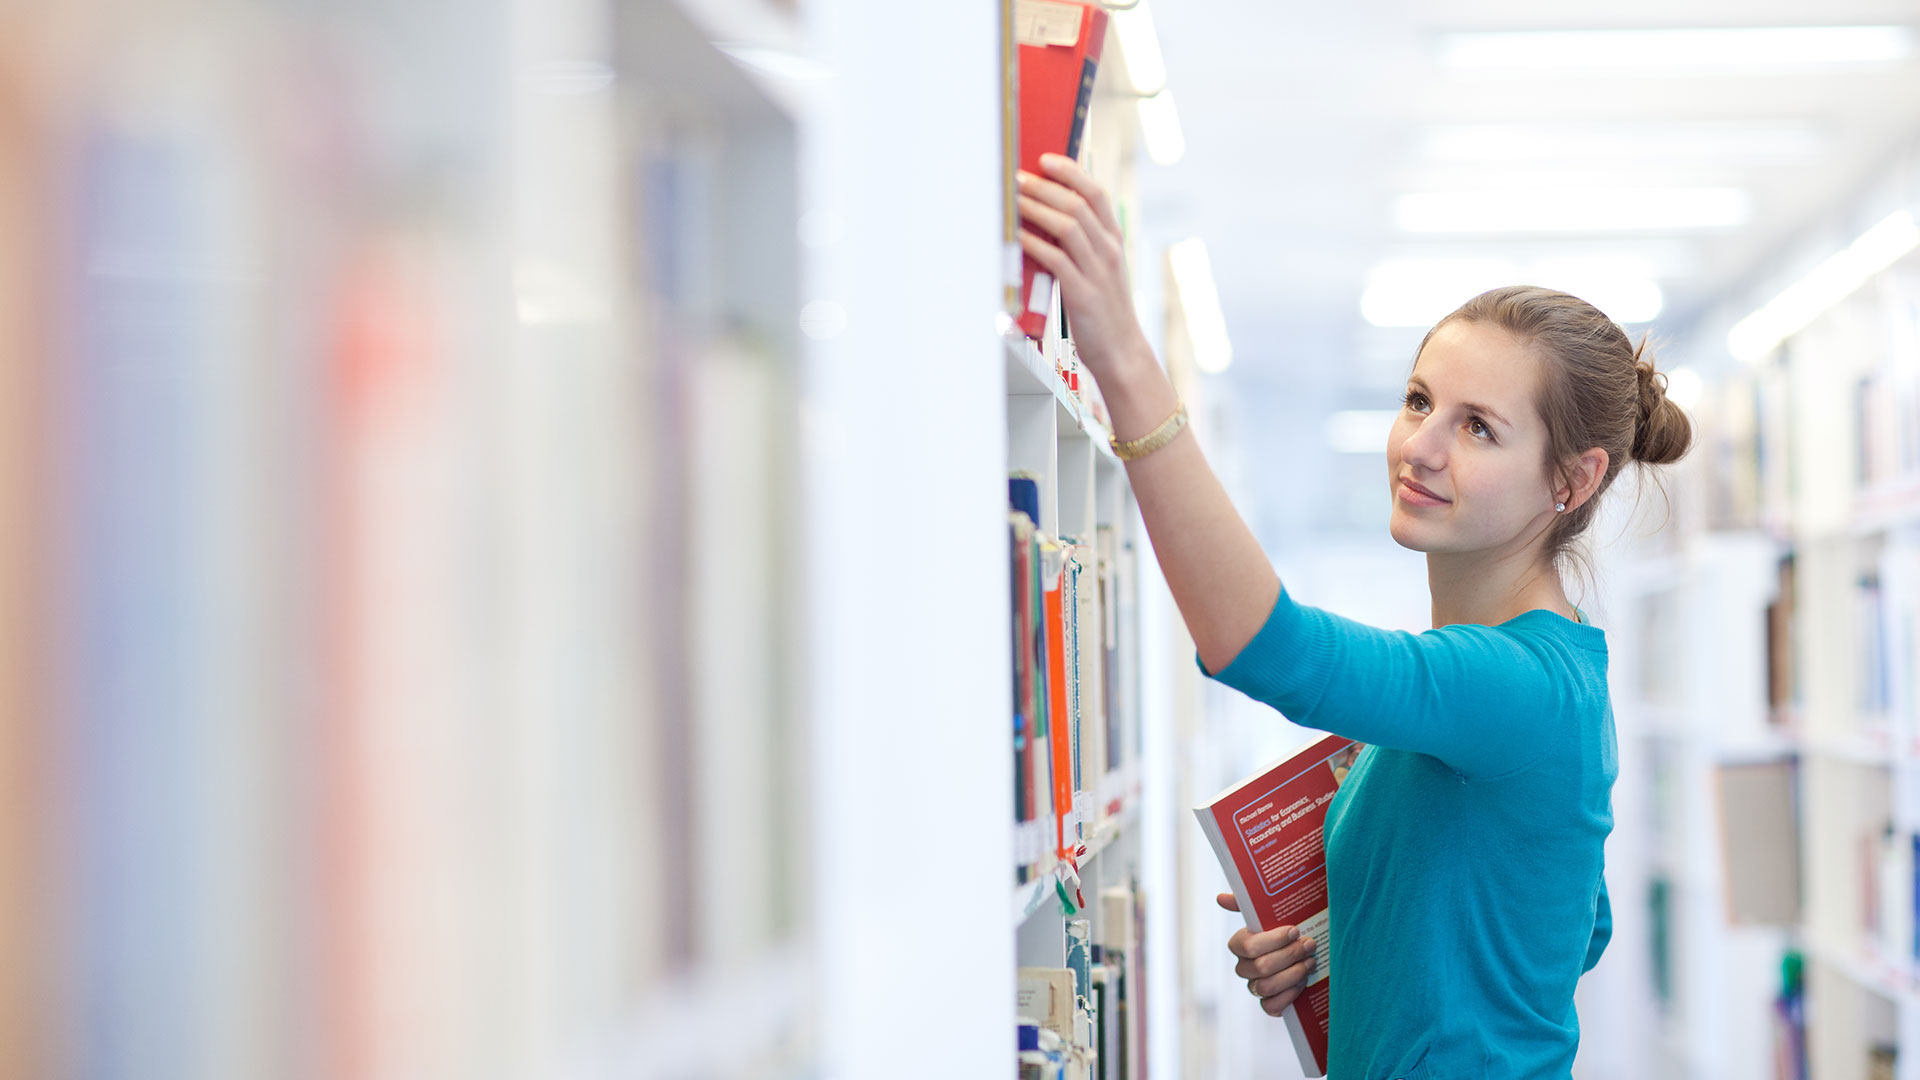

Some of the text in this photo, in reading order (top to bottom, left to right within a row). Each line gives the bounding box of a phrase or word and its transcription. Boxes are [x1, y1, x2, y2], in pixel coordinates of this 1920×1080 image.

[1245, 819, 1272, 838] Statistics
[1271, 814, 1280, 822] for
[1249, 824, 1281, 846] Accounting
[1280, 816, 1293, 828] and
[1291, 803, 1316, 821] Business
